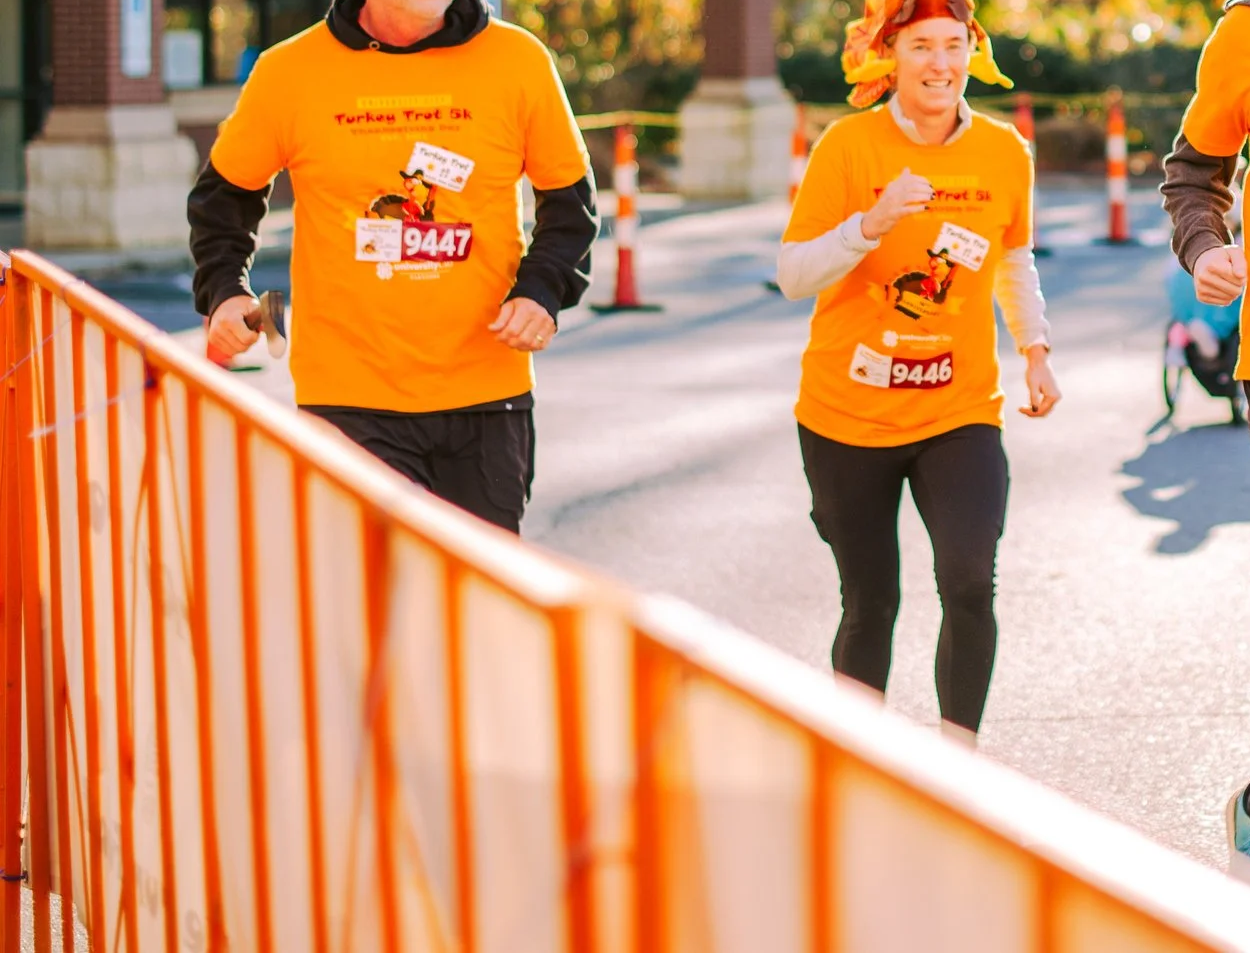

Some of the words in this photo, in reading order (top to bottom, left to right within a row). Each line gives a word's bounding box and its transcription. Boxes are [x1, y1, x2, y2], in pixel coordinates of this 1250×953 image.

[335, 111, 396, 126] Turkey
[402, 109, 441, 121] Trot
[449, 108, 473, 121] 5k
[936, 190, 969, 201] Trot
[403, 227, 472, 257] 9447
[892, 357, 953, 385] 9446
